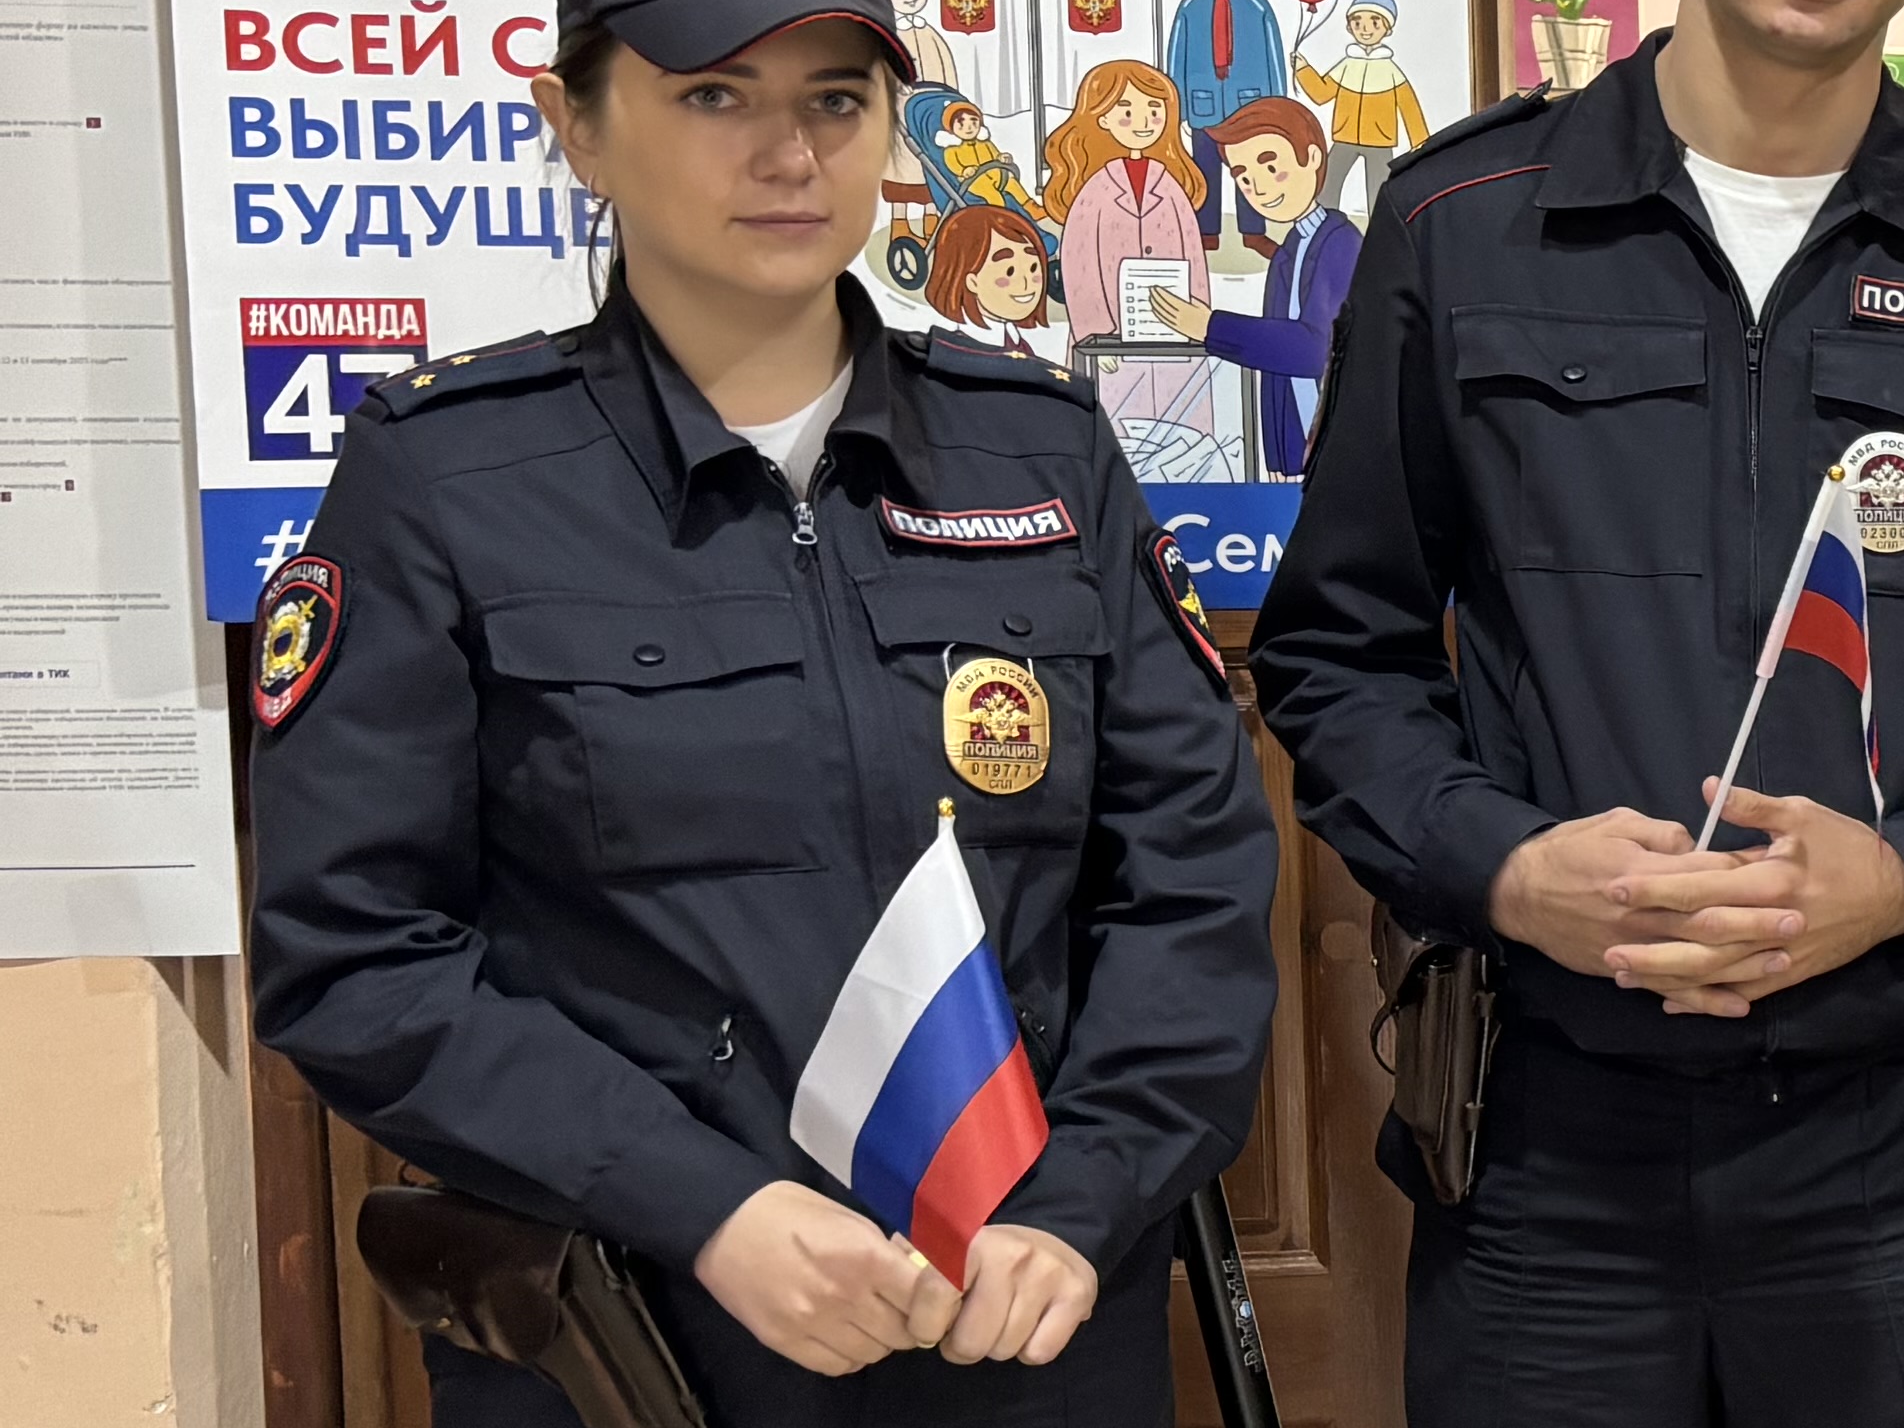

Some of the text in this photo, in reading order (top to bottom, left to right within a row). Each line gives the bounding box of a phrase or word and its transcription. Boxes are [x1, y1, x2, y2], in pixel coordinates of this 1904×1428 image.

[248, 303, 421, 340] #КОМАНДА
[892, 507, 1064, 542] ПОЛИЦИЯ
[990, 665, 1040, 699] РОССИИ
[964, 742, 1038, 760] ПОЛИЦИЯ
[971, 762, 1032, 778] 019771
